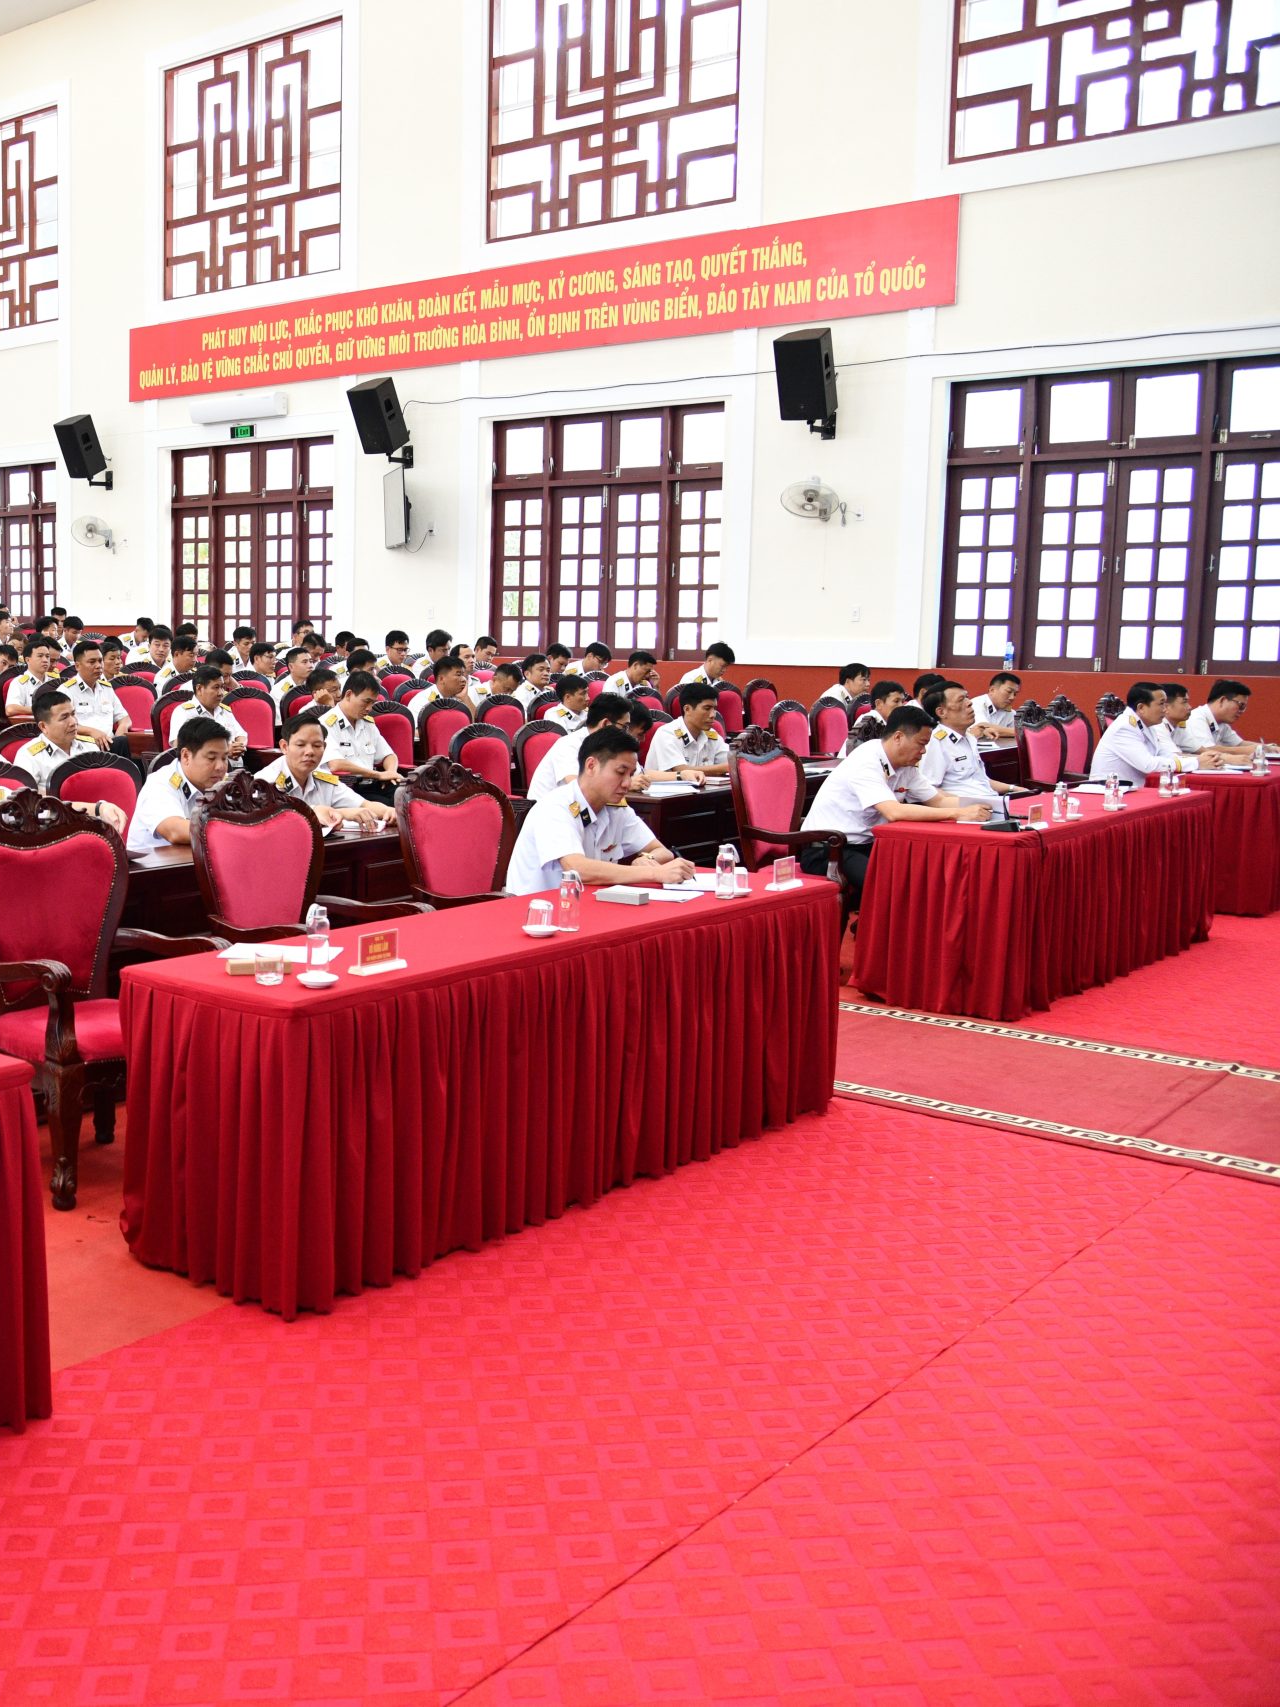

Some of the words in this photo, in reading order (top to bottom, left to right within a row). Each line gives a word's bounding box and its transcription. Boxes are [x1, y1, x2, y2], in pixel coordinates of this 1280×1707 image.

[140, 364, 163, 390] QUẢN
[166, 362, 179, 386] LÝ,
[181, 358, 199, 382] BẢO
[202, 358, 213, 383] VỆ
[244, 347, 270, 374] CHẮC
[273, 344, 293, 371] CHỦ
[296, 340, 332, 370] QUYỀN,
[336, 337, 355, 362] GIỮ
[389, 330, 410, 355] MÔI
[413, 324, 459, 353] TRƯỜNG
[462, 319, 486, 346] HÒA
[490, 315, 523, 343] BÌNH,
[549, 310, 580, 339] ĐỊNH
[584, 302, 618, 330] TRÊN
[622, 297, 660, 325] VÙNG
[664, 287, 702, 320] BIỂN,
[707, 281, 737, 316] ĐẢO
[742, 281, 770, 311] TÂY
[774, 279, 811, 306] NAM
[816, 267, 849, 302] CỦA
[854, 260, 876, 296] TỔ
[880, 255, 927, 296] QUỐC
[202, 327, 226, 351] PHÁT
[228, 326, 247, 347] HUY
[249, 320, 267, 346] NỘI
[270, 319, 292, 343] LỰC,
[295, 309, 322, 337] KHẮC
[325, 309, 353, 335] PHỤC
[356, 303, 378, 328] KHÓ
[381, 298, 415, 324] KHĂN,
[418, 292, 450, 319] ĐOÀN
[454, 286, 477, 314] KẾT,
[480, 280, 508, 310] MẪU
[512, 280, 544, 309] MỰC,
[548, 270, 565, 300] KỶ
[569, 270, 618, 298] CƯƠNG,
[623, 262, 661, 290] SÁNG
[665, 258, 696, 287] TẠO,
[701, 244, 747, 281] QUYẾT
[751, 236, 807, 271] THẮNG,
